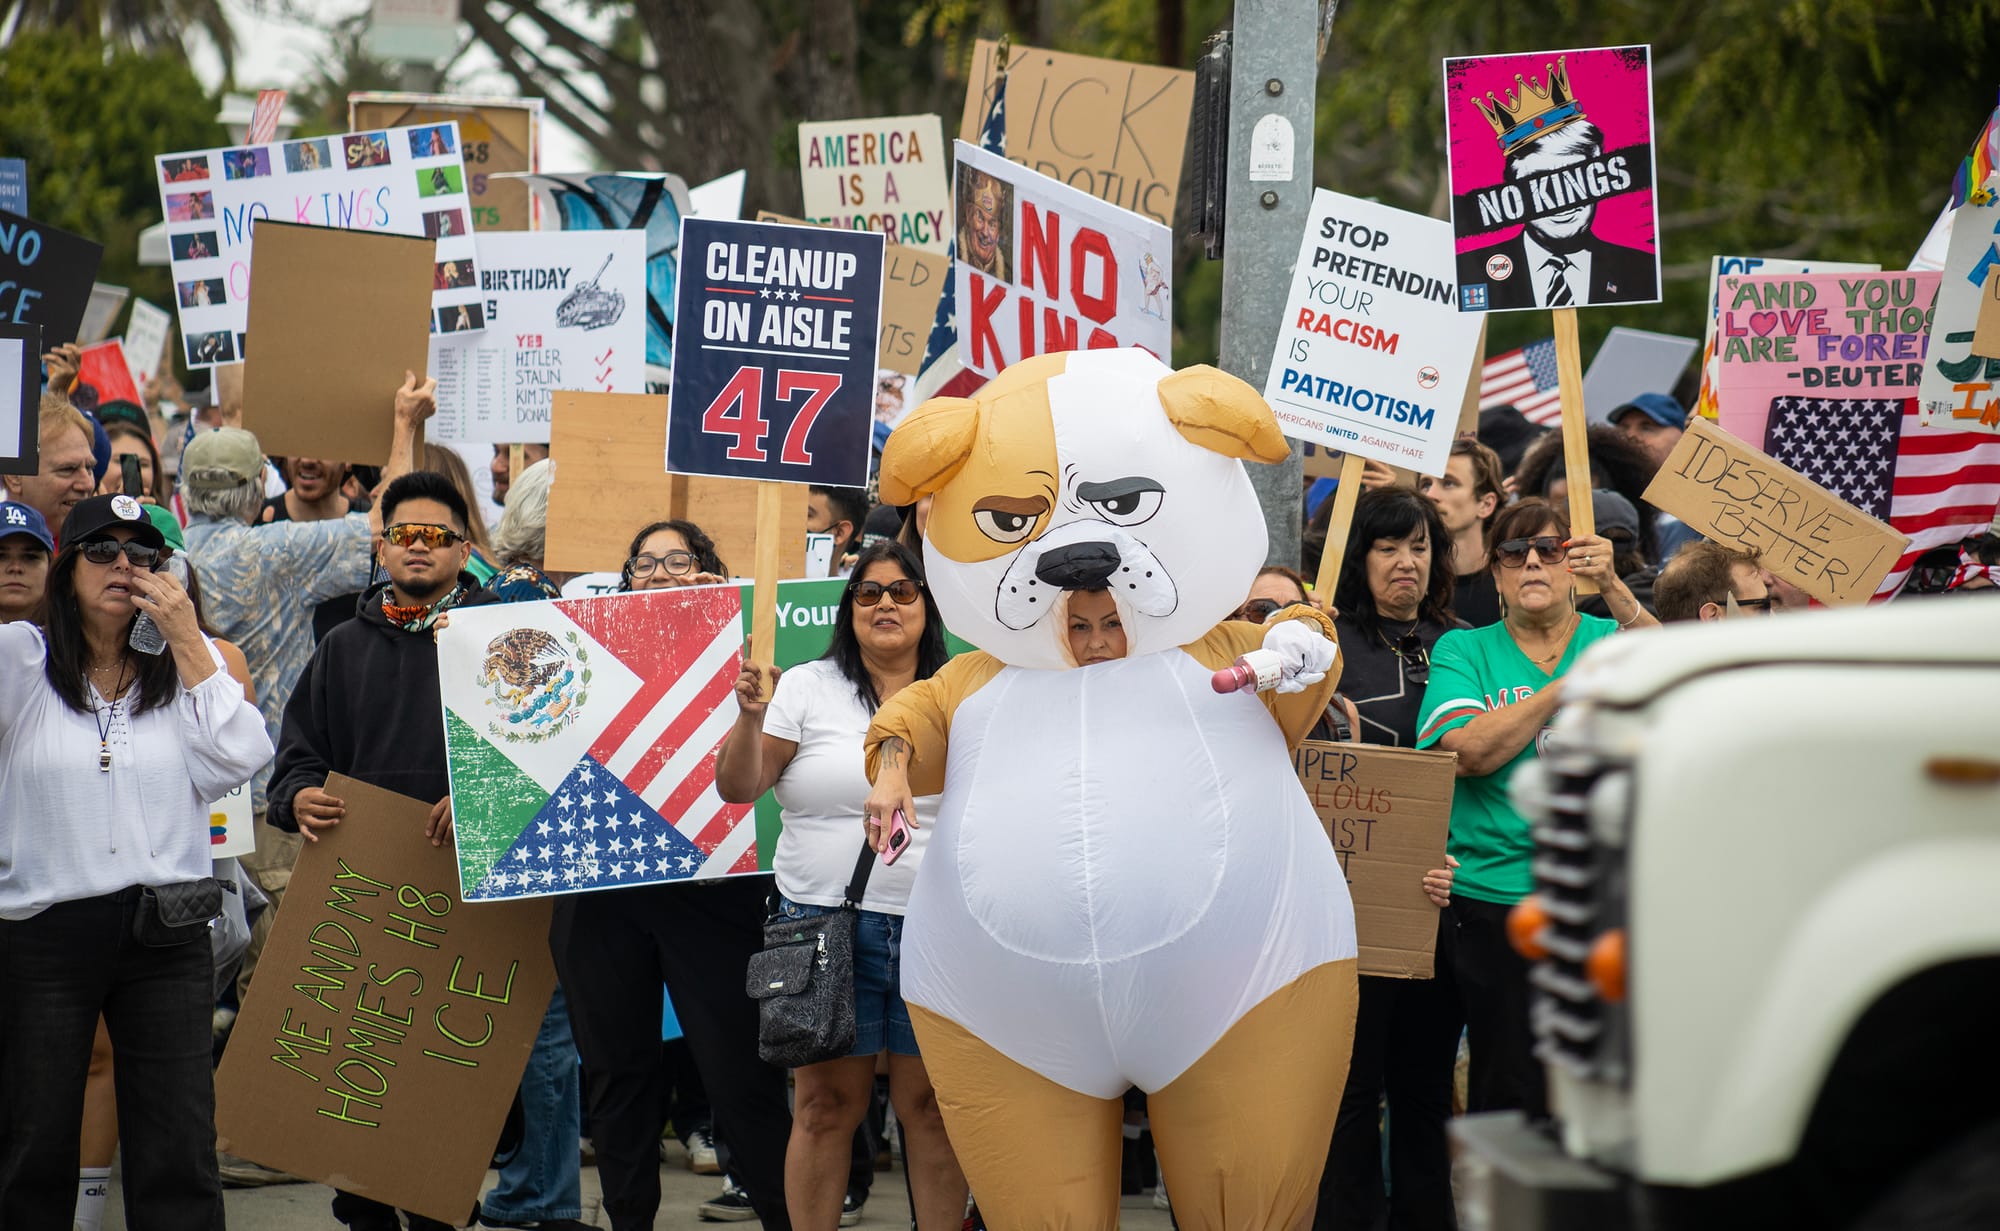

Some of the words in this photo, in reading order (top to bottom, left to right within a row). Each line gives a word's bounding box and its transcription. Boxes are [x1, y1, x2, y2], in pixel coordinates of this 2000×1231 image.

[808, 130, 922, 168] AMERICA
[296, 186, 391, 229] KINGS
[839, 173, 864, 206] IS
[884, 171, 899, 203] A
[1477, 182, 1525, 227] NO
[1529, 155, 1632, 214] KINGS
[1320, 216, 1389, 251] STOP
[481, 267, 571, 291] BIRTHDAY
[706, 241, 857, 291] CLEANUP
[1020, 200, 1118, 325] NO
[1312, 247, 1455, 306] PRETENDIN
[1307, 276, 1373, 316] YOUR
[1839, 278, 1915, 310] YOU
[516, 335, 542, 348] YES
[703, 299, 751, 343] ON
[758, 304, 852, 351] AISLE
[1296, 307, 1399, 355] RACISM
[515, 349, 562, 367] HITLER
[1289, 337, 1310, 362] IS
[1724, 336, 1798, 362] ARE
[515, 370, 561, 385] STALIN
[516, 388, 536, 405] KIM
[701, 365, 843, 466] 47
[1281, 368, 1435, 430] PATRIOTISM
[1326, 424, 1359, 441] UNITED
[1361, 435, 1400, 452] AGAINST
[1402, 446, 1425, 460] HATE
[776, 602, 840, 628] Your
[1311, 783, 1391, 814] LOUS
[1319, 817, 1377, 852] IST
[325, 857, 394, 923] MY
[293, 920, 362, 1013] AND
[316, 962, 424, 1128] HOMIES
[383, 883, 452, 949] H8
[423, 955, 519, 1067] ICE
[271, 1008, 332, 1082] ME
